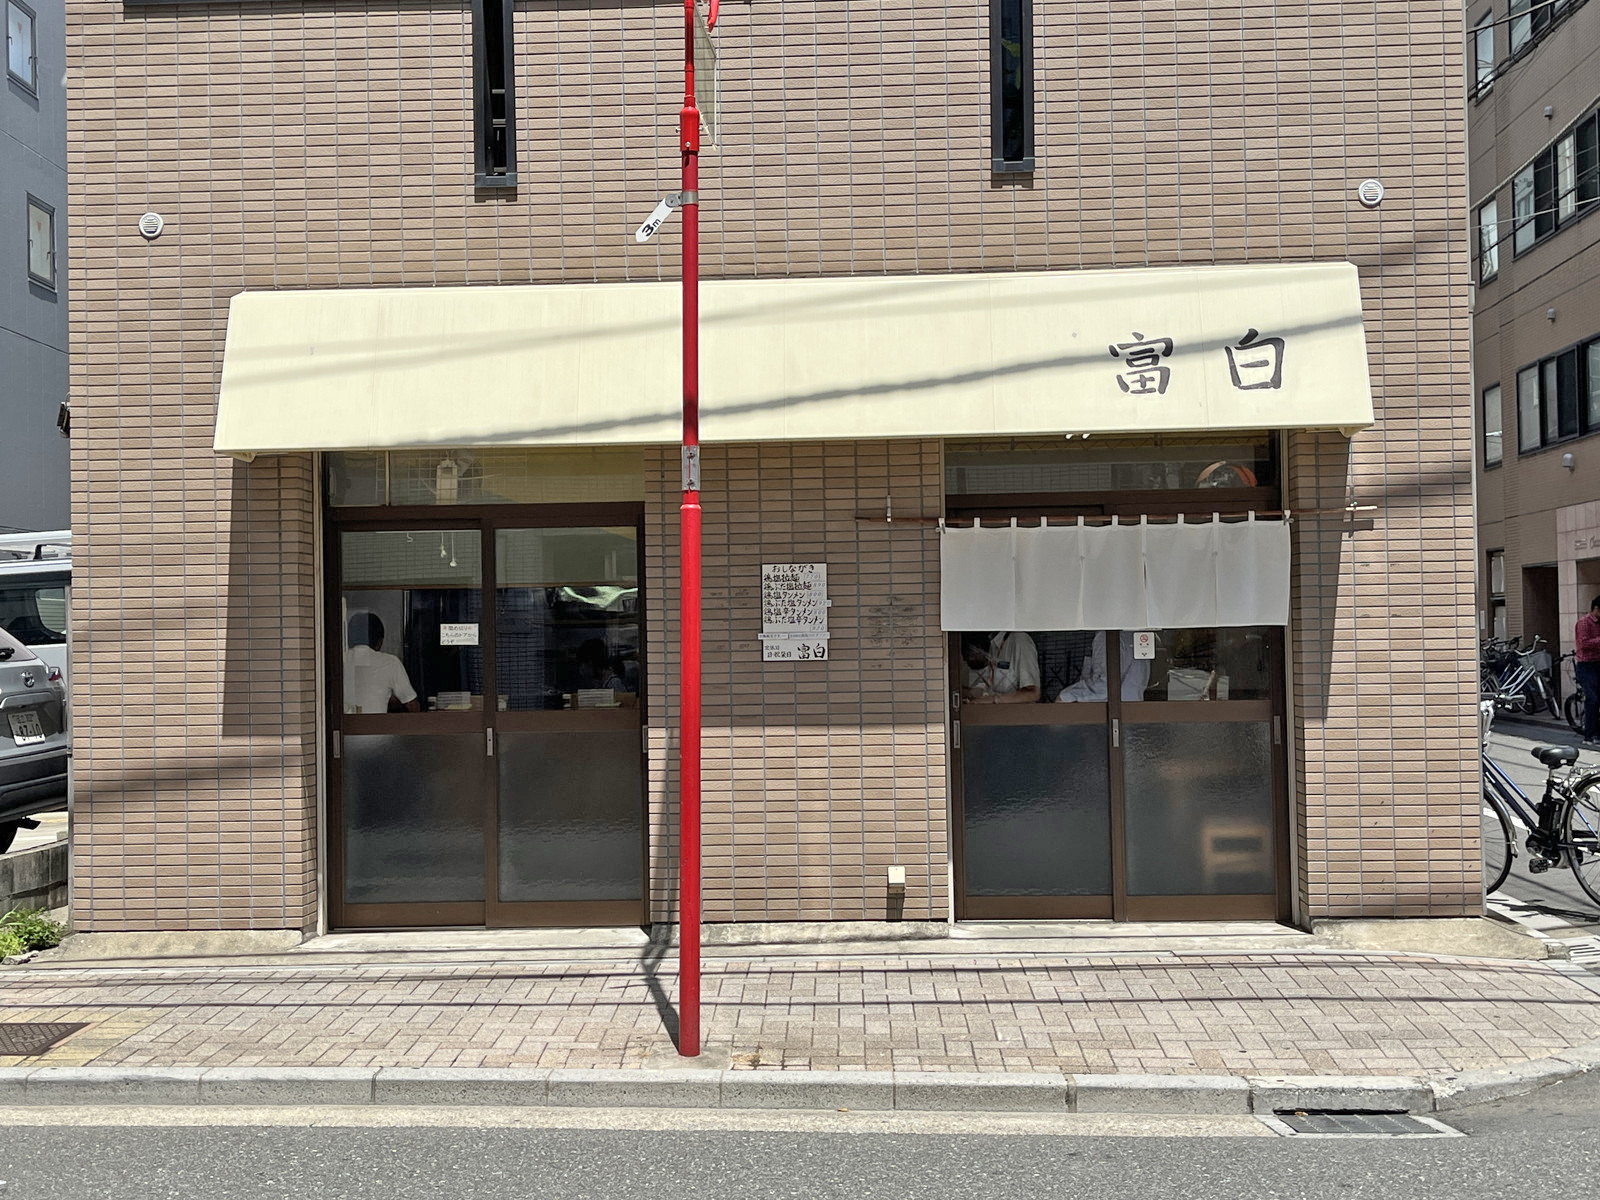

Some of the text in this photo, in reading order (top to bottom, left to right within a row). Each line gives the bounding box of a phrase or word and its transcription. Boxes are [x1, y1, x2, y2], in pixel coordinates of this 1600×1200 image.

[641, 218, 661, 237] 3m
[1108, 328, 1286, 395] 富白
[772, 565, 814, 573] おしながき
